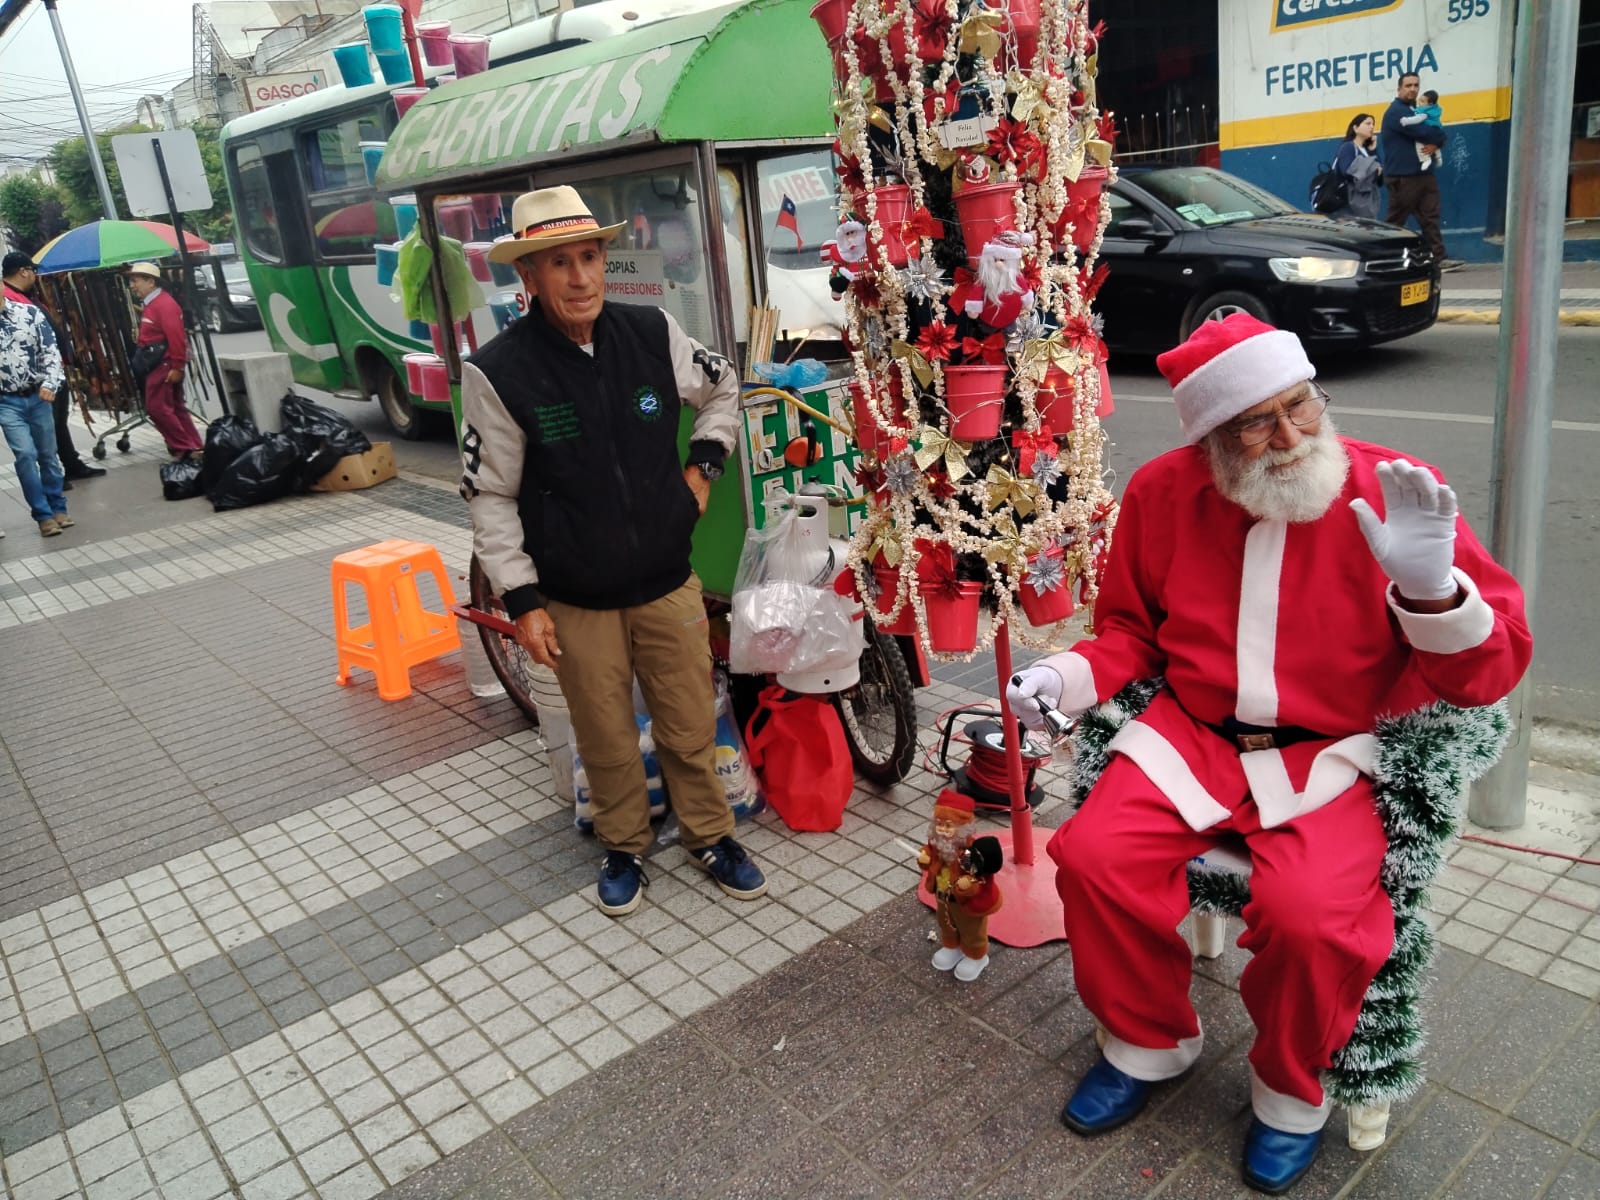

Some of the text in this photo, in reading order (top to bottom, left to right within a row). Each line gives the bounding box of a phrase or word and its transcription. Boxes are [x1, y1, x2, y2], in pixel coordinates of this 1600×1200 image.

[1447, 0, 1491, 23] 595
[1266, 43, 1439, 96] FERRETERIA
[256, 82, 317, 101] GASCO
[387, 45, 672, 178] CABRITAS
[541, 218, 578, 230] VALDIVIA
[604, 281, 664, 296] IMPRESIONES
